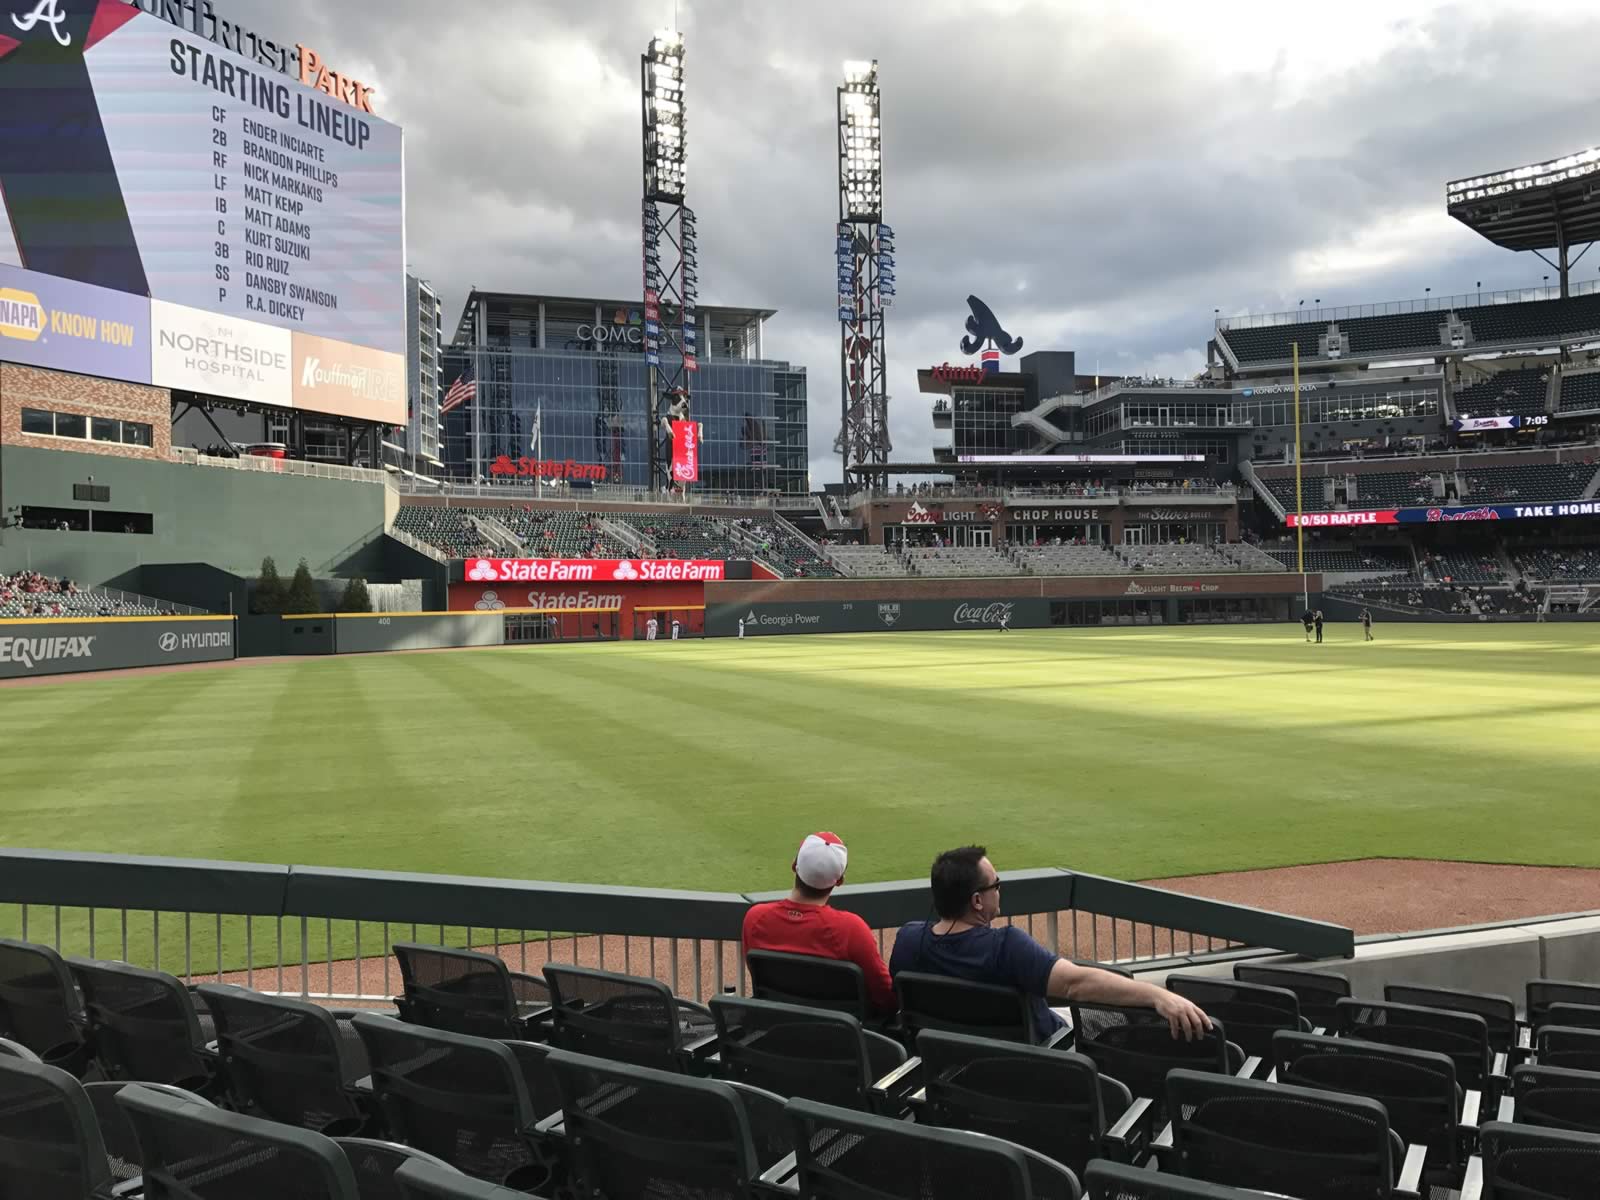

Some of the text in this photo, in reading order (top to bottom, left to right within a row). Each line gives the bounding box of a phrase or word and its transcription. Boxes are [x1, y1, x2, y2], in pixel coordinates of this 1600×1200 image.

[170, 38, 370, 150] STARTING LINEUP
[296, 43, 376, 116] PARK
[212, 105, 324, 163] CF ENDER INCIARTE
[213, 128, 338, 188] 2B BRANDON PHILLIPS
[213, 150, 323, 203] RF NICK MARKAKIS
[214, 174, 303, 216] LF MATT KEMP
[245, 206, 273, 228] MATT
[275, 216, 311, 240] ADAMS
[218, 220, 310, 261] C KURT SUZUKI
[215, 241, 290, 276] 3B RIO RUIZ
[215, 264, 338, 309] SS DANSBY SWANSON
[0, 300, 38, 328] NAPA
[219, 287, 305, 321] P R.A. DICKEY
[51, 309, 134, 347] KNOW HOW
[576, 323, 678, 346] COMCST
[159, 329, 287, 370] NORTHSIDE
[184, 356, 265, 382] HOSPITAL
[931, 361, 988, 385] xfinity
[1253, 384, 1317, 395] KONICA MIOLTA
[1525, 415, 1548, 425] 7:05
[943, 512, 976, 521] LIGHT
[1013, 509, 1099, 520] CHOP HOUSE
[1331, 512, 1377, 525] RAFFLE
[1515, 502, 1600, 517] TAKE HOME
[378, 617, 391, 625] 400
[760, 613, 820, 626] Georgia Power
[0, 635, 93, 668] EQUIFAX
[181, 632, 231, 649] HYUNDAI
